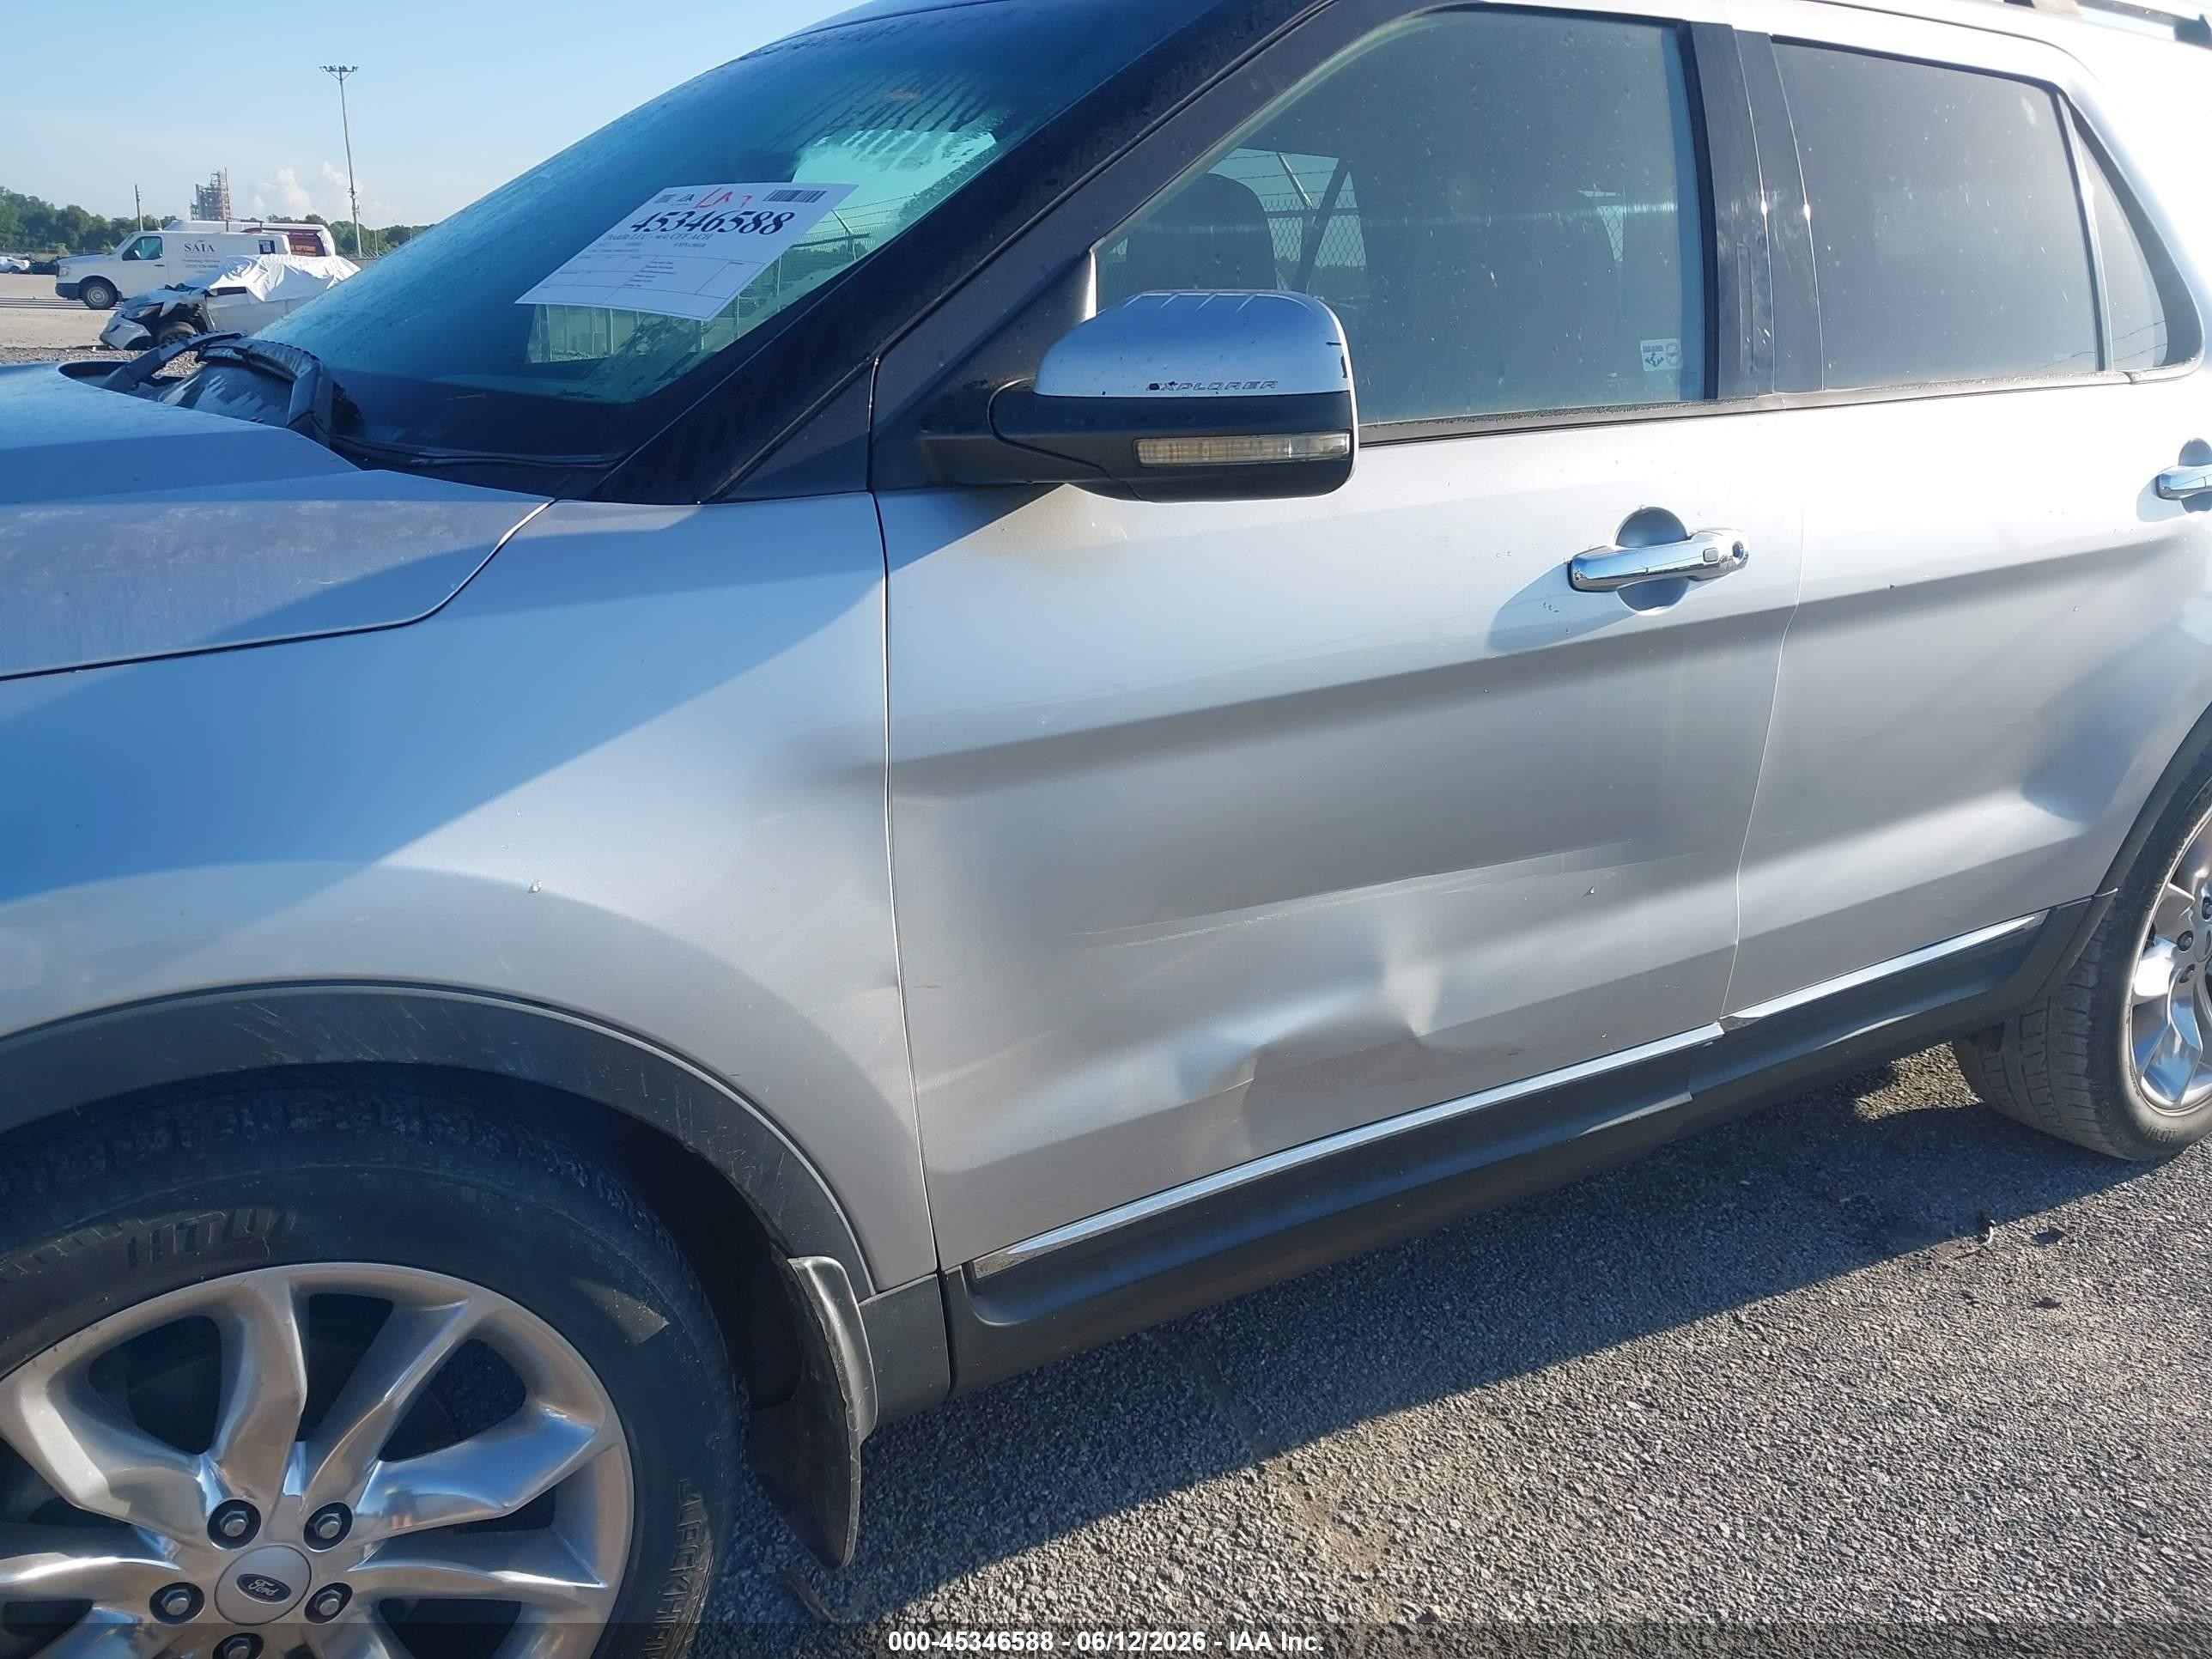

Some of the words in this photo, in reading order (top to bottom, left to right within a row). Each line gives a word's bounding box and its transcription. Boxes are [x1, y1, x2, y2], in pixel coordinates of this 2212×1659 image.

[630, 210, 794, 234] 45346588
[184, 243, 215, 252] SAIA
[248, 1579, 279, 1596] Ford
